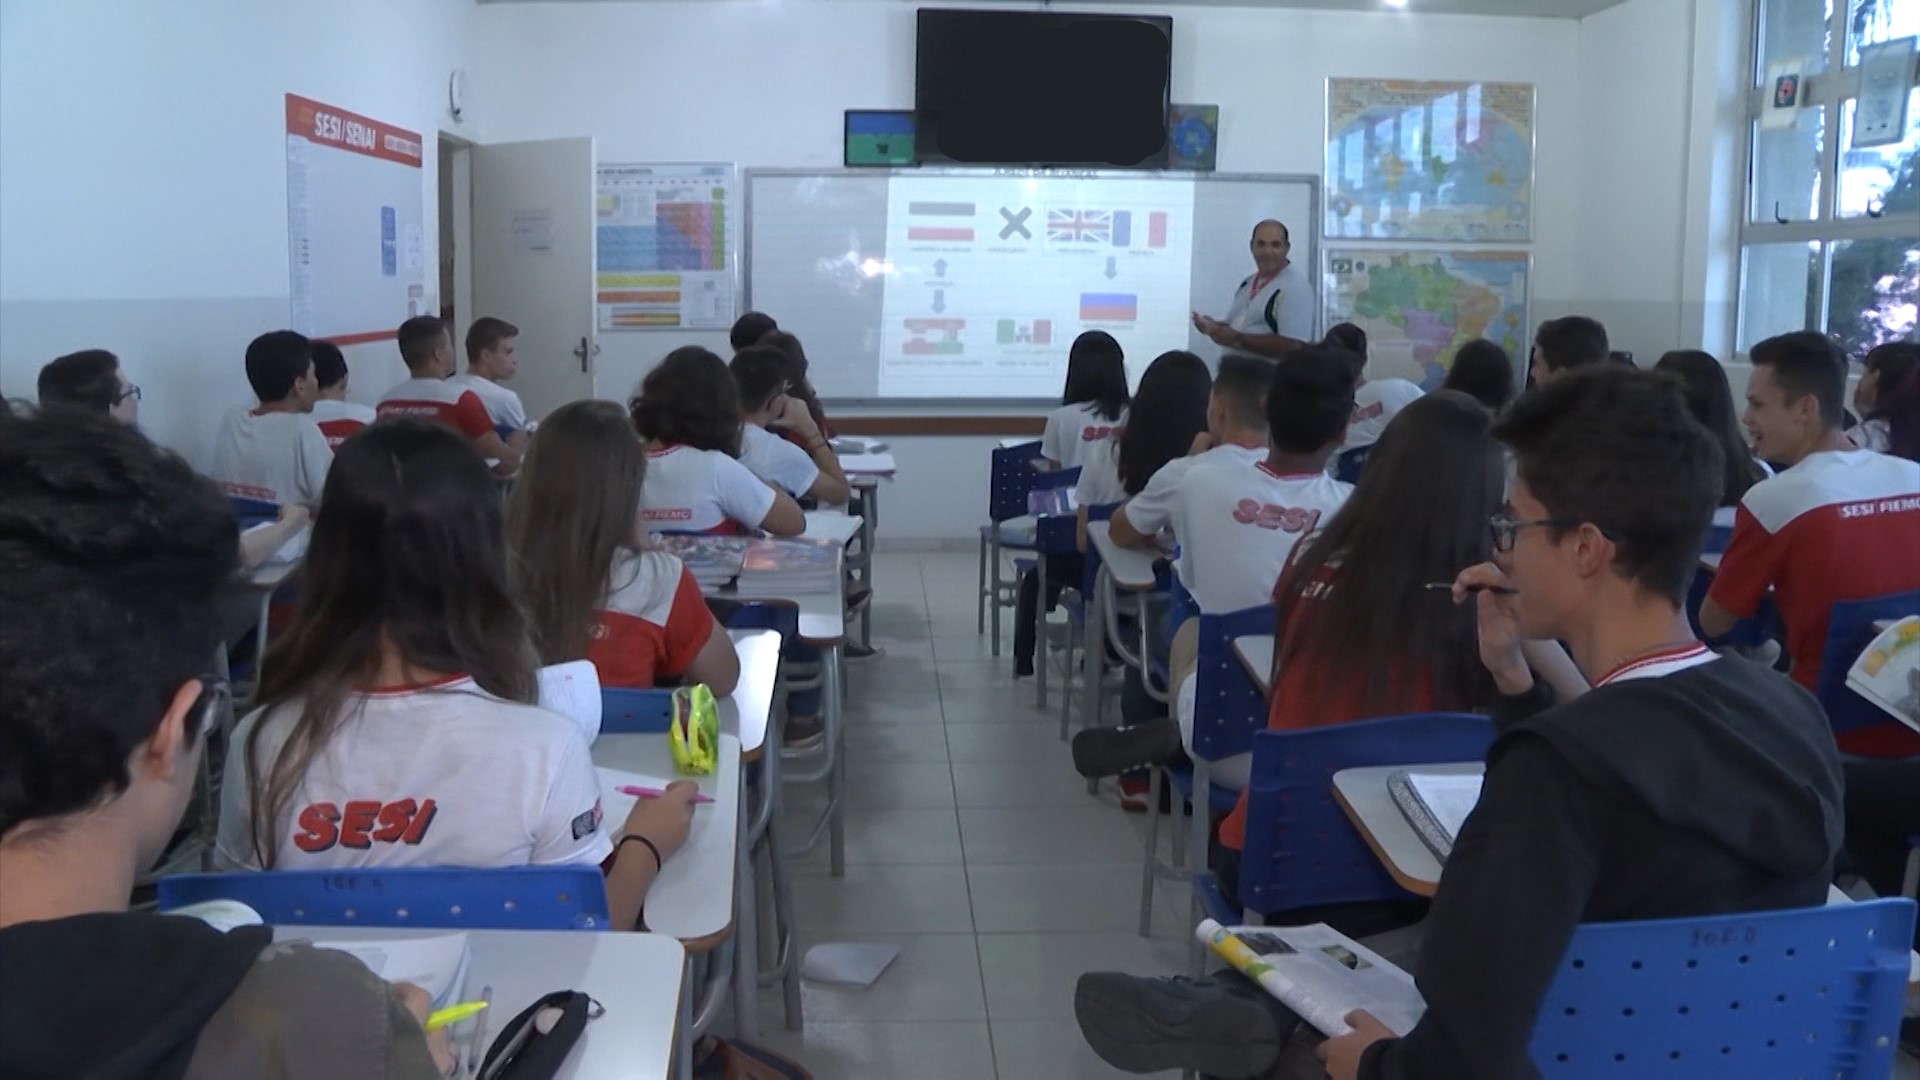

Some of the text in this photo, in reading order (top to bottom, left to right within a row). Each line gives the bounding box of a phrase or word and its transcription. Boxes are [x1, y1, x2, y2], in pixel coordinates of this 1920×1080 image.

[1082, 425, 1123, 441] SES
[1232, 498, 1321, 533] SESI
[1841, 503, 1874, 518] SESI
[293, 797, 438, 853] SESI
